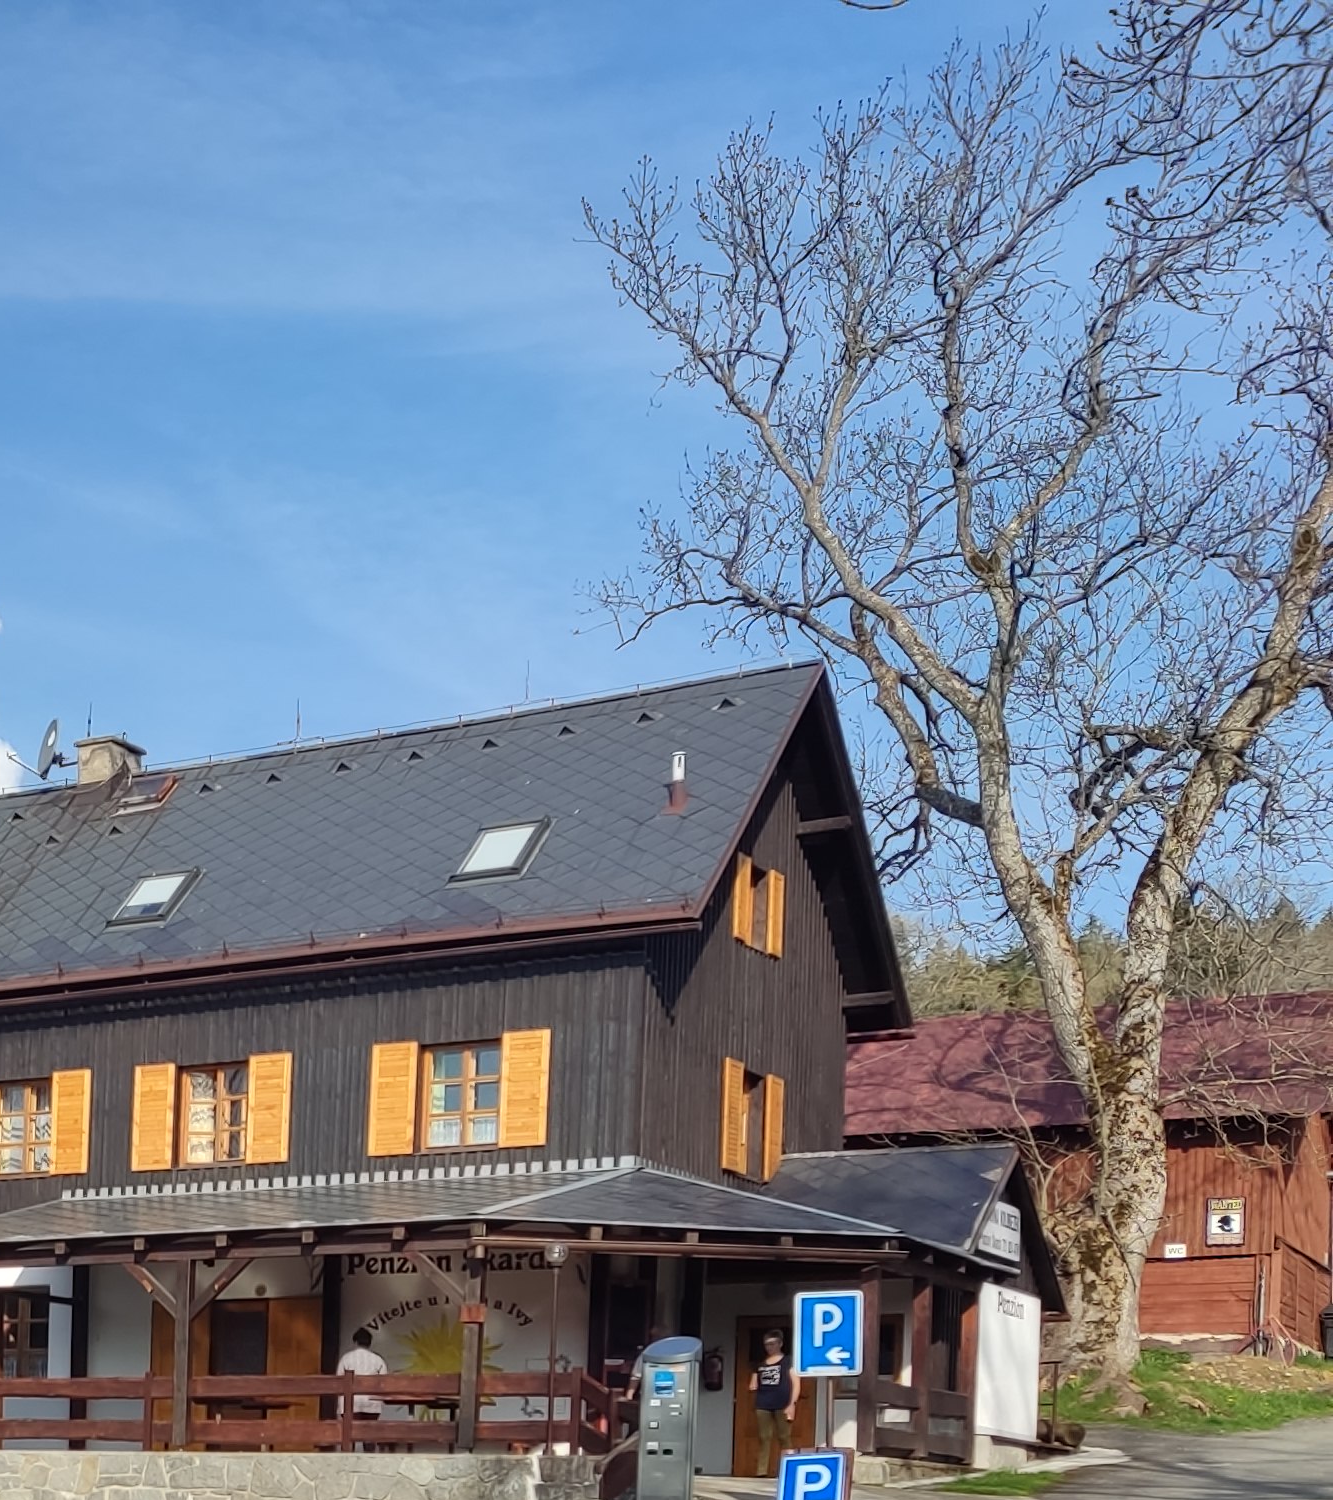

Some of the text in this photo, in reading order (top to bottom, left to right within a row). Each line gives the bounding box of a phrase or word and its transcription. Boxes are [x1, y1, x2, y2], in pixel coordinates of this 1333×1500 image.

[1167, 1247, 1184, 1255] WC
[507, 1302, 534, 1327] Ivy
[814, 1303, 843, 1347] P
